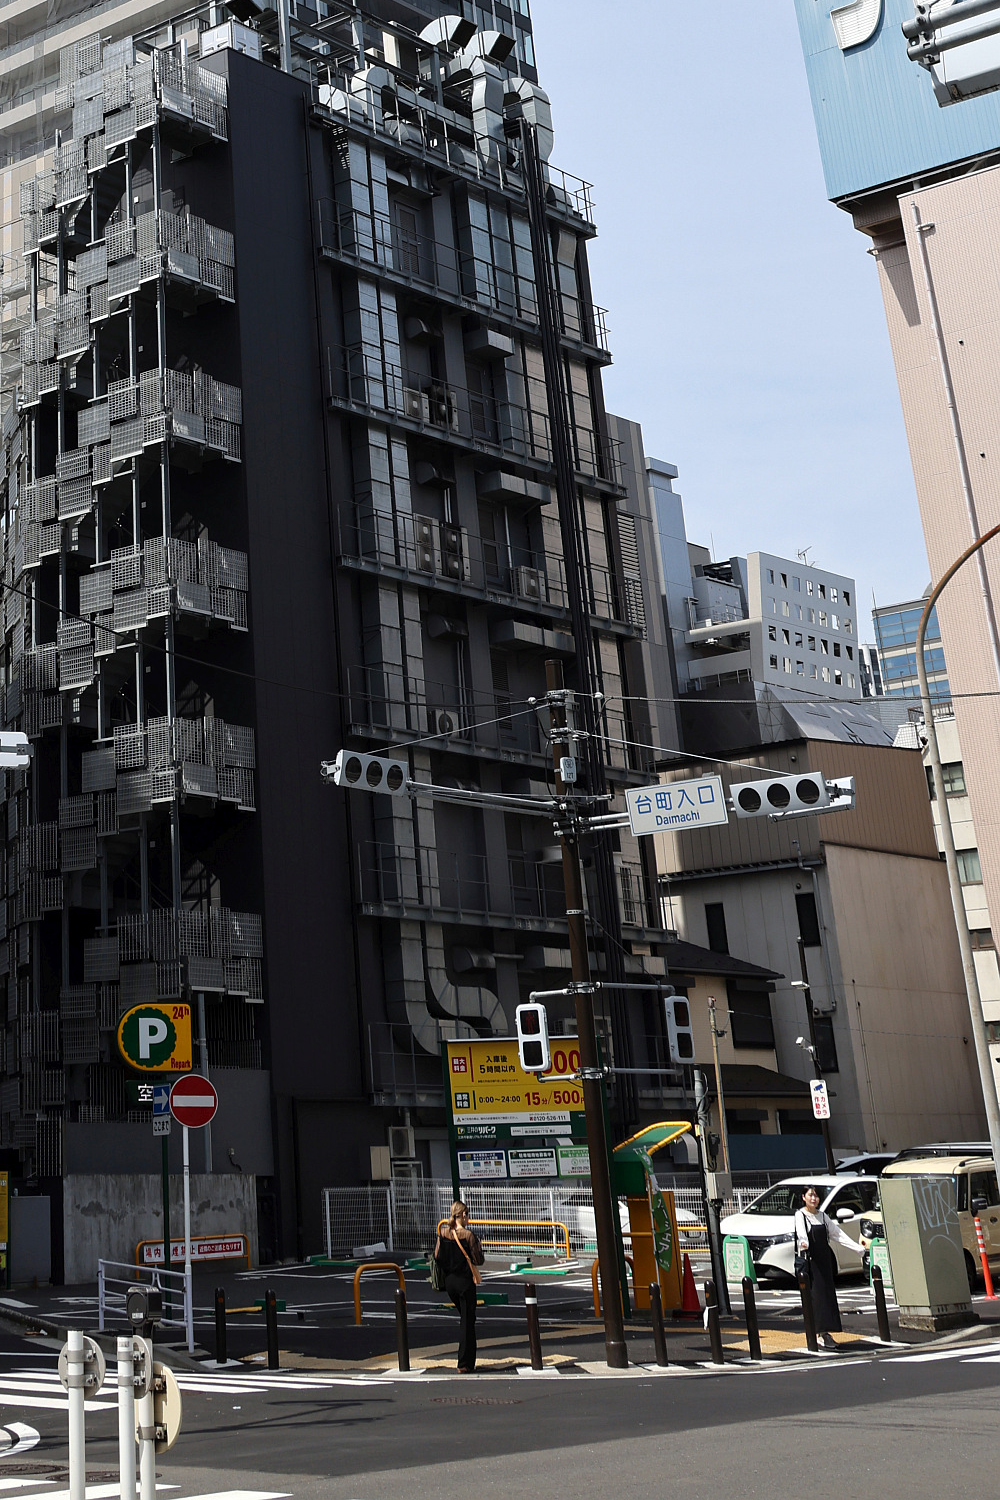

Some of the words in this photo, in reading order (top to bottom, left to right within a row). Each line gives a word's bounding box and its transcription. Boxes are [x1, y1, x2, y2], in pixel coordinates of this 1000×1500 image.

[635, 785, 715, 814] 台町入口
[655, 810, 700, 826] Daimachi
[172, 1006, 190, 1019] 24h
[138, 1017, 168, 1059] P
[170, 1057, 191, 1070] Repark
[480, 1065, 516, 1074] 5時間以内
[138, 1083, 153, 1102] 空
[154, 1120, 169, 1132] ここまで
[467, 1125, 496, 1134] 三井のリパーク
[145, 1245, 196, 1258] 場内煙禁止
